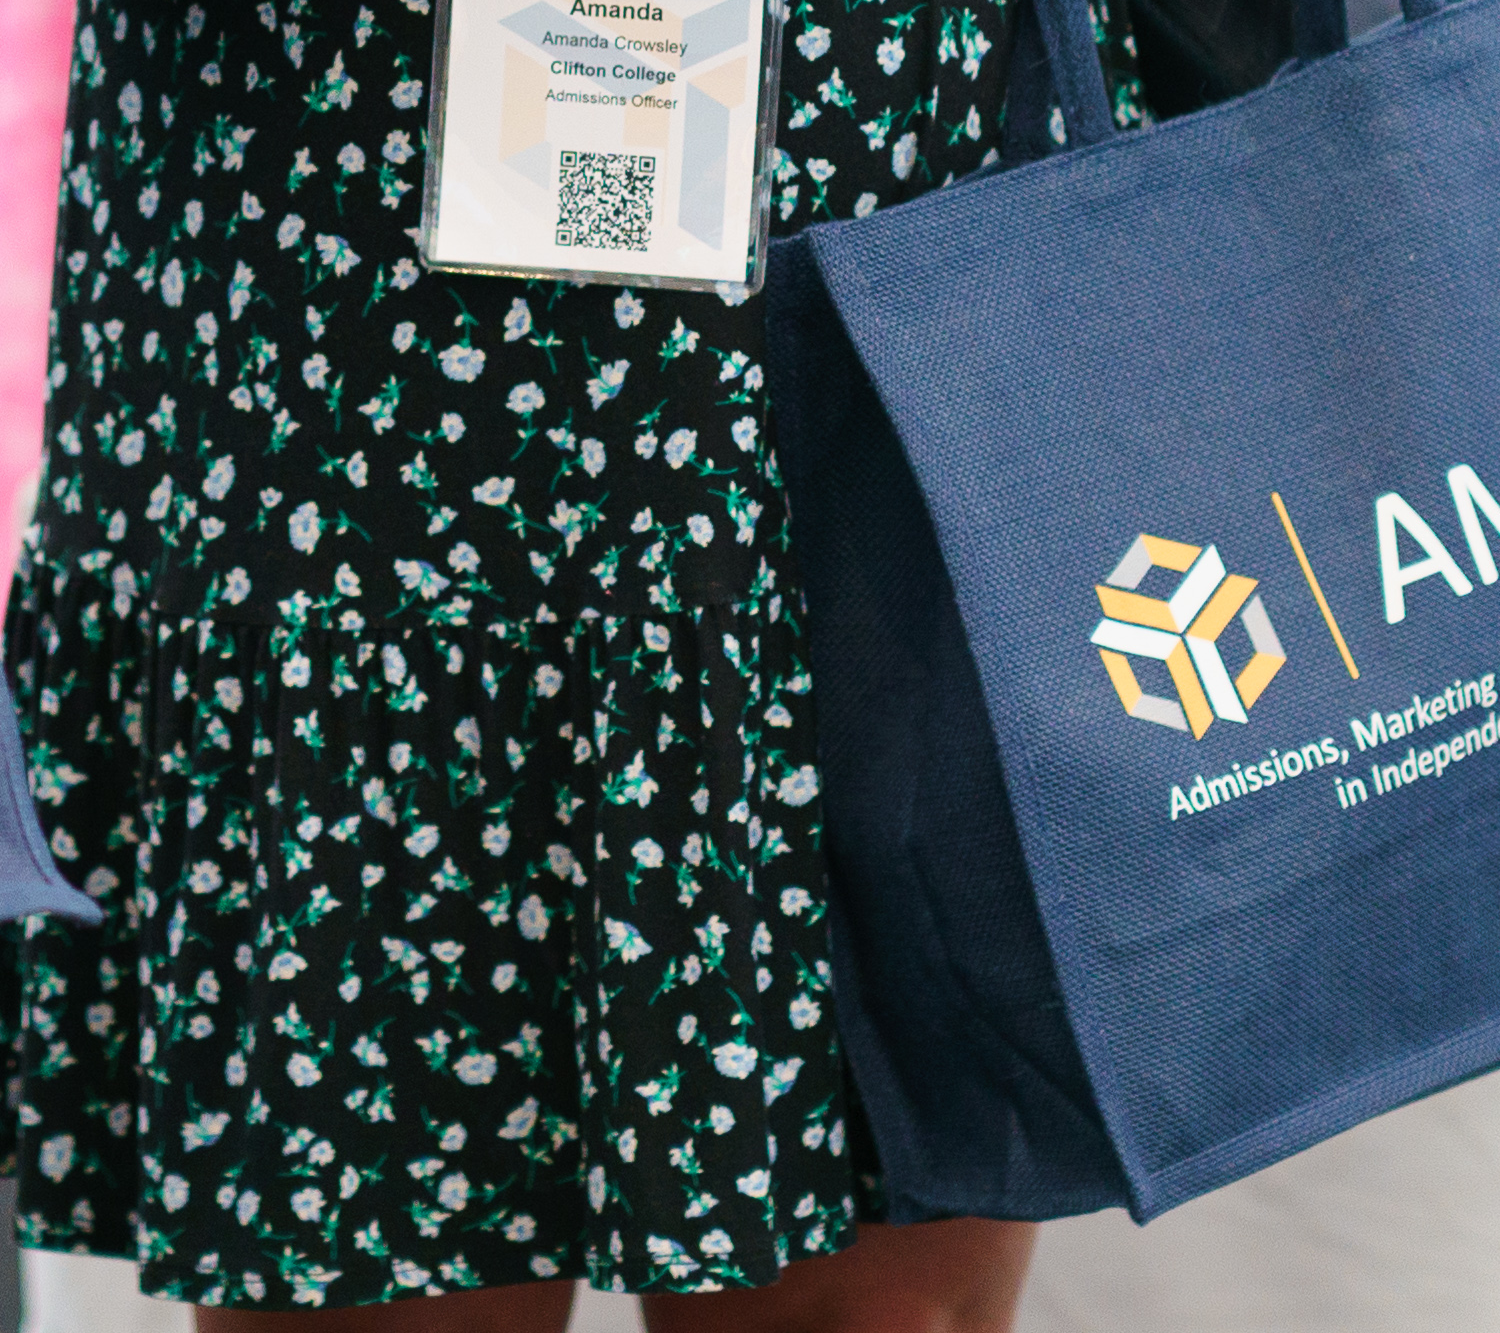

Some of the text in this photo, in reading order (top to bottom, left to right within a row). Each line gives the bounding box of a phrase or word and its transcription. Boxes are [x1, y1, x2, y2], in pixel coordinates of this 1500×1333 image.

[542, 30, 689, 58] Amanda Crowsley
[550, 60, 677, 85] Clifton College
[545, 88, 679, 110] Admissions Officer
[1169, 737, 1350, 822] Admissions,
[1349, 671, 1499, 752] Marketing
[1334, 776, 1369, 810] in
